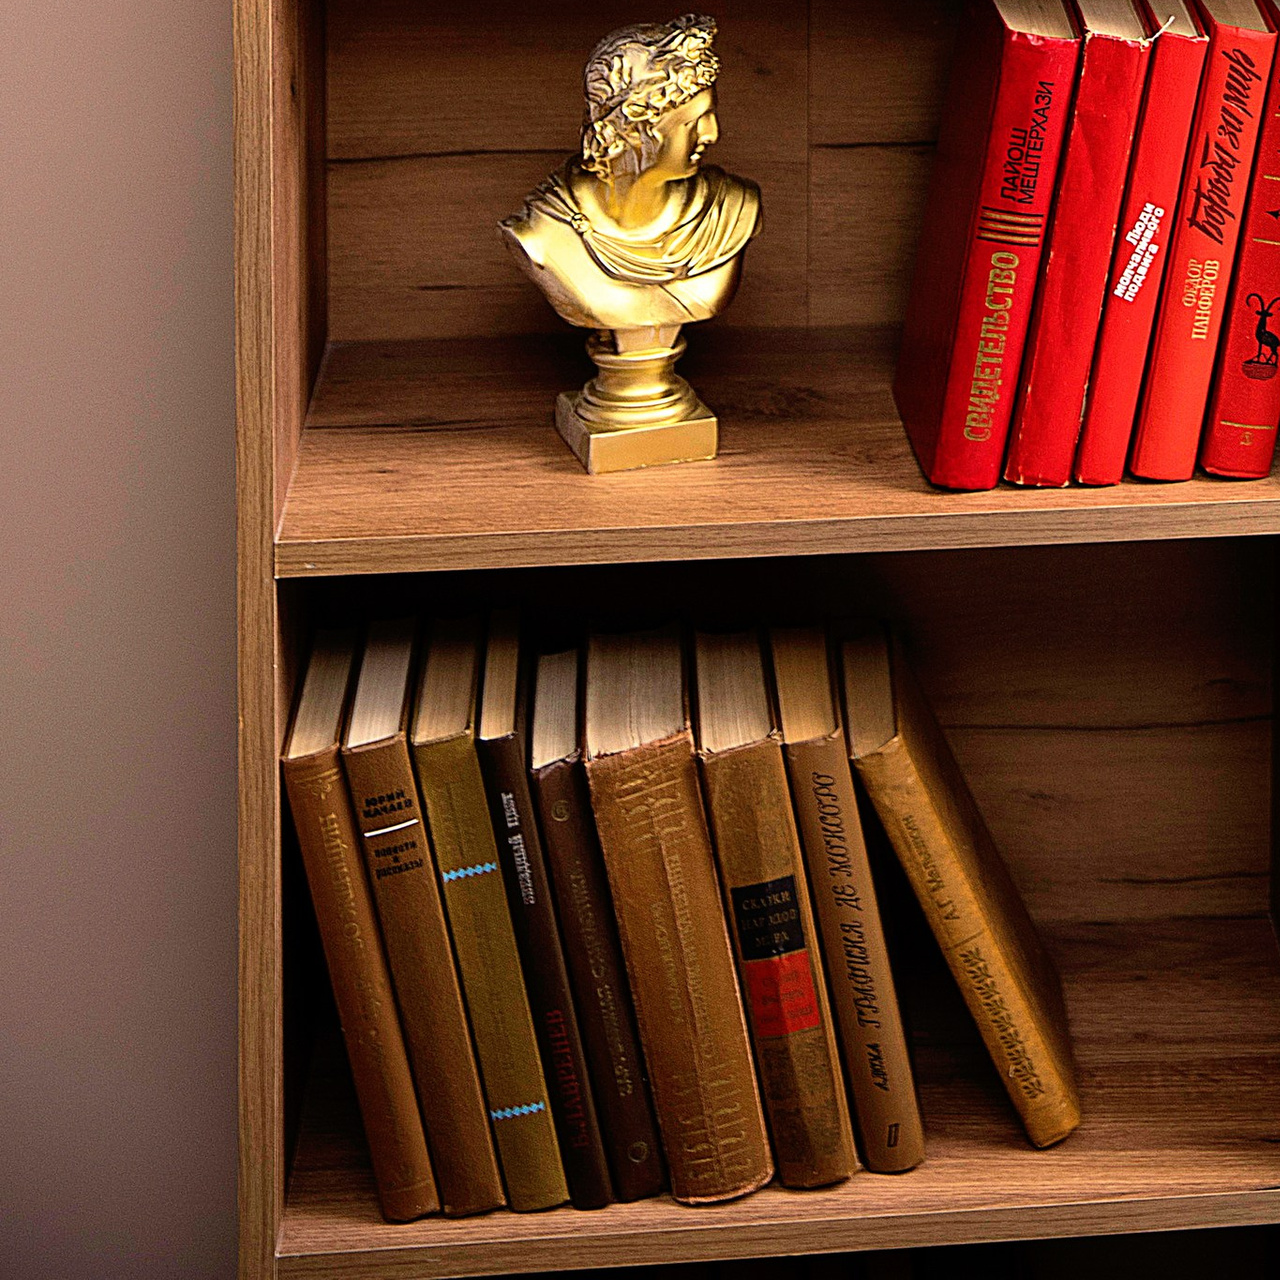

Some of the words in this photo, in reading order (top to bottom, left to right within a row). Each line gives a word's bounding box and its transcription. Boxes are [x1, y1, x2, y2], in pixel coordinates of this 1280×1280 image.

[1001, 128, 1028, 202] ЛАЙОШ
[1018, 81, 1055, 204] МЕШТЕРХАЗИ
[1126, 202, 1156, 246] Люди
[1182, 258, 1203, 308] ФЕДОР
[1191, 259, 1220, 340] ПАНФЕРОВ
[964, 250, 1020, 442] СВИДЕТЕЛЬСТВО
[811, 771, 855, 875] МОНСОРО
[835, 881, 863, 911] ДЕ
[838, 920, 881, 1029] ГРАФИНЯ
